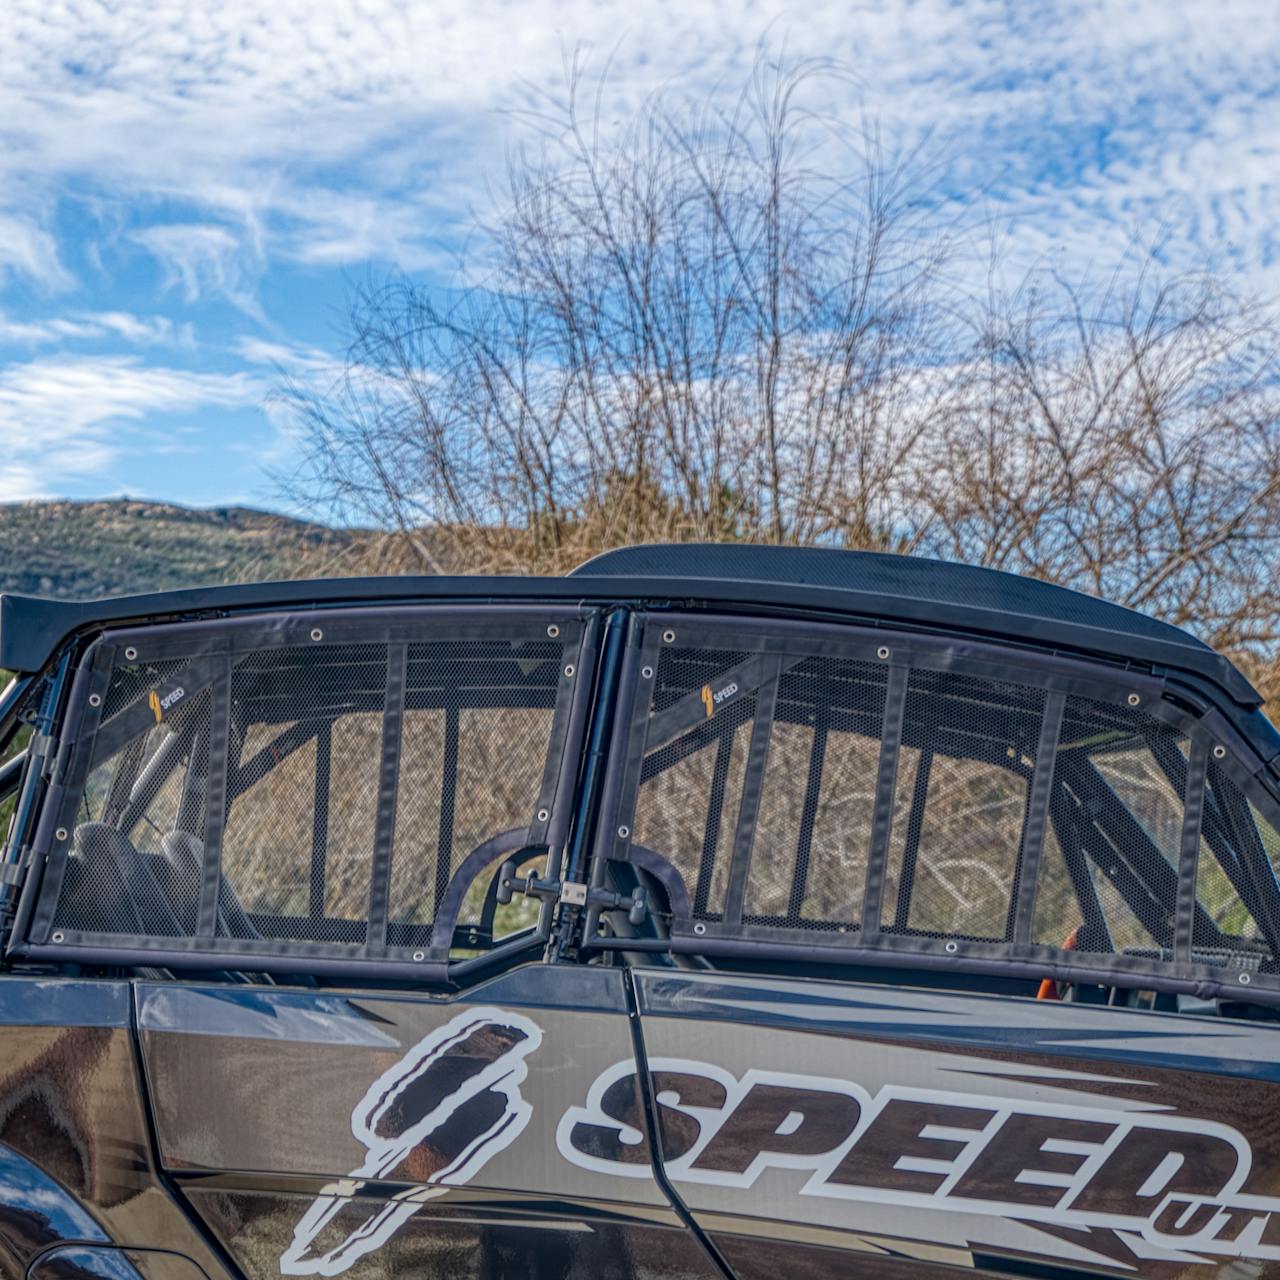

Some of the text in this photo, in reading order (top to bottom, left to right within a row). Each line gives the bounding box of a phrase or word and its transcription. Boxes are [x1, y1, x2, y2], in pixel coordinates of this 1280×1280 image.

[160, 687, 185, 709] SPEED
[713, 683, 738, 703] SPEED
[558, 1059, 1250, 1222] SPEED
